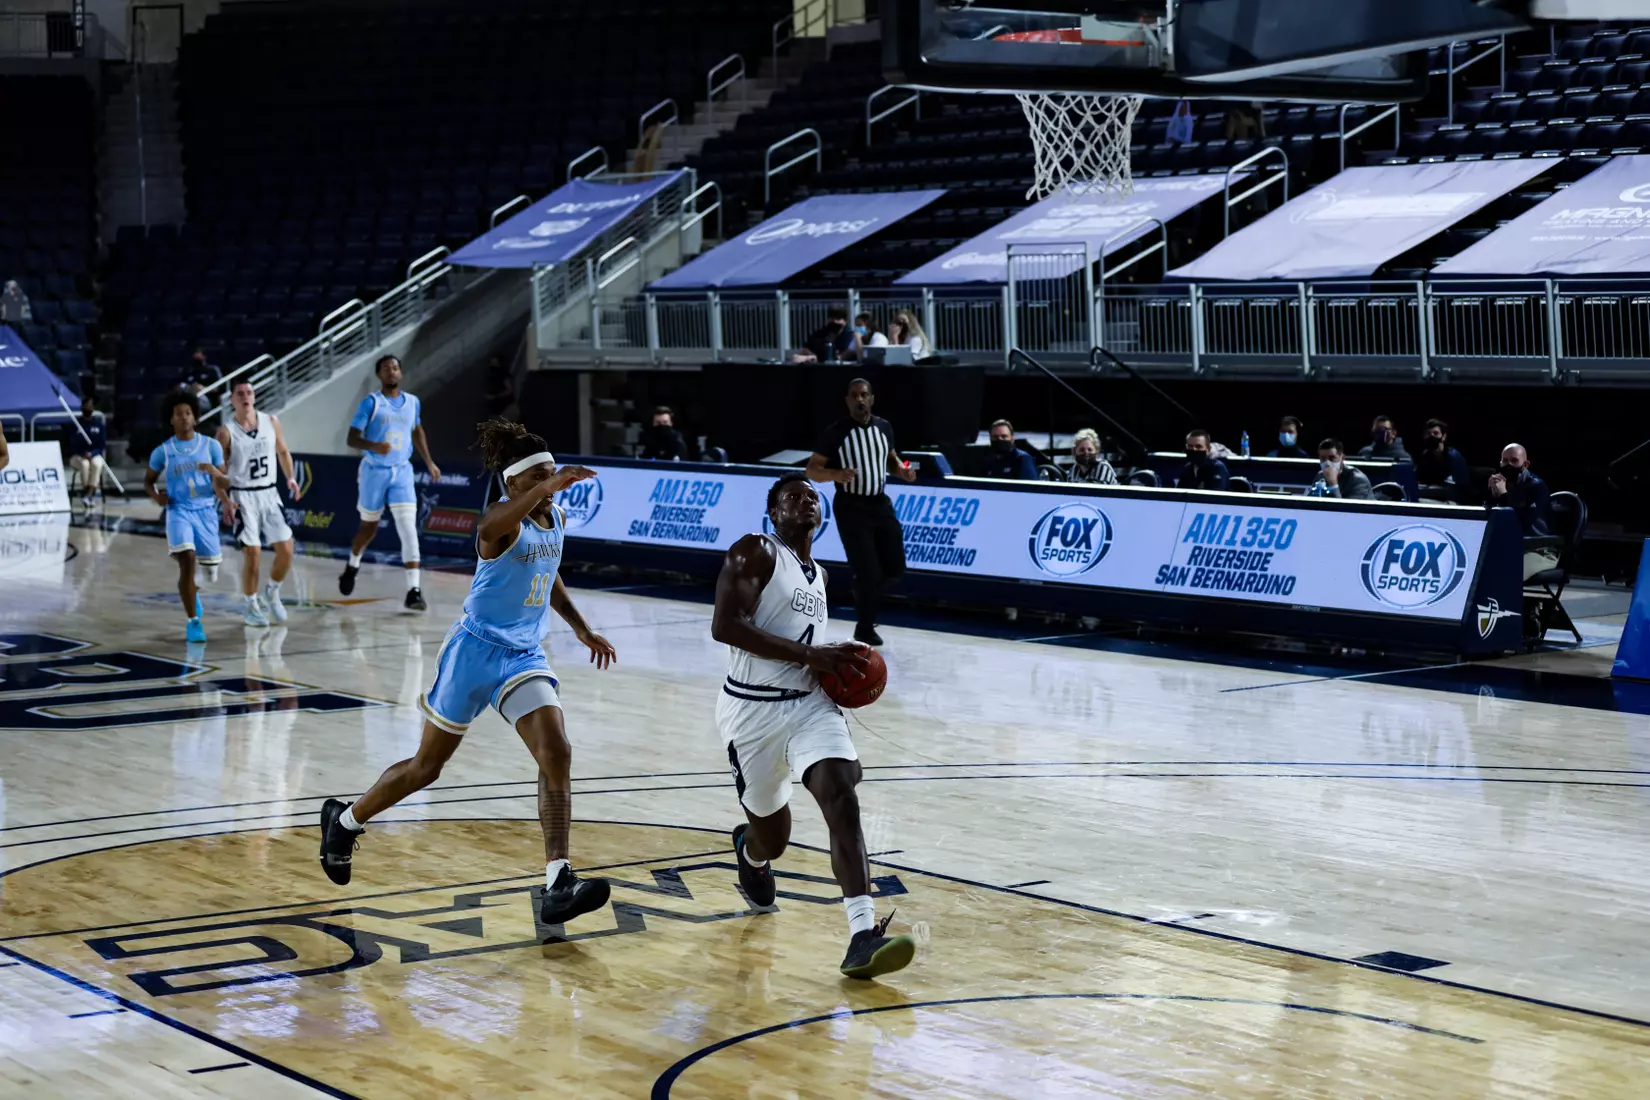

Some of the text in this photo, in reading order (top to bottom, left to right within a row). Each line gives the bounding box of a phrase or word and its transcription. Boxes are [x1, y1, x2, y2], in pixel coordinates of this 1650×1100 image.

[249, 456, 268, 480] 25
[558, 483, 594, 509] FOX
[649, 478, 724, 507] AM1350
[650, 504, 707, 524] RIVERSIDE
[893, 494, 980, 526] AM1350
[628, 519, 720, 544] SAN BERNARDINO
[1045, 515, 1099, 550] FOX
[1183, 513, 1297, 550] AM1350
[904, 543, 977, 567] ERNARDINO
[1041, 548, 1092, 564] SPORTS
[1187, 545, 1274, 572] RIVERSIDE
[1381, 539, 1449, 578] FOX
[523, 573, 550, 606] 11
[1155, 564, 1296, 596] SAN BERNARDINO
[1377, 575, 1441, 594] SPORTS
[791, 588, 826, 623] CBU
